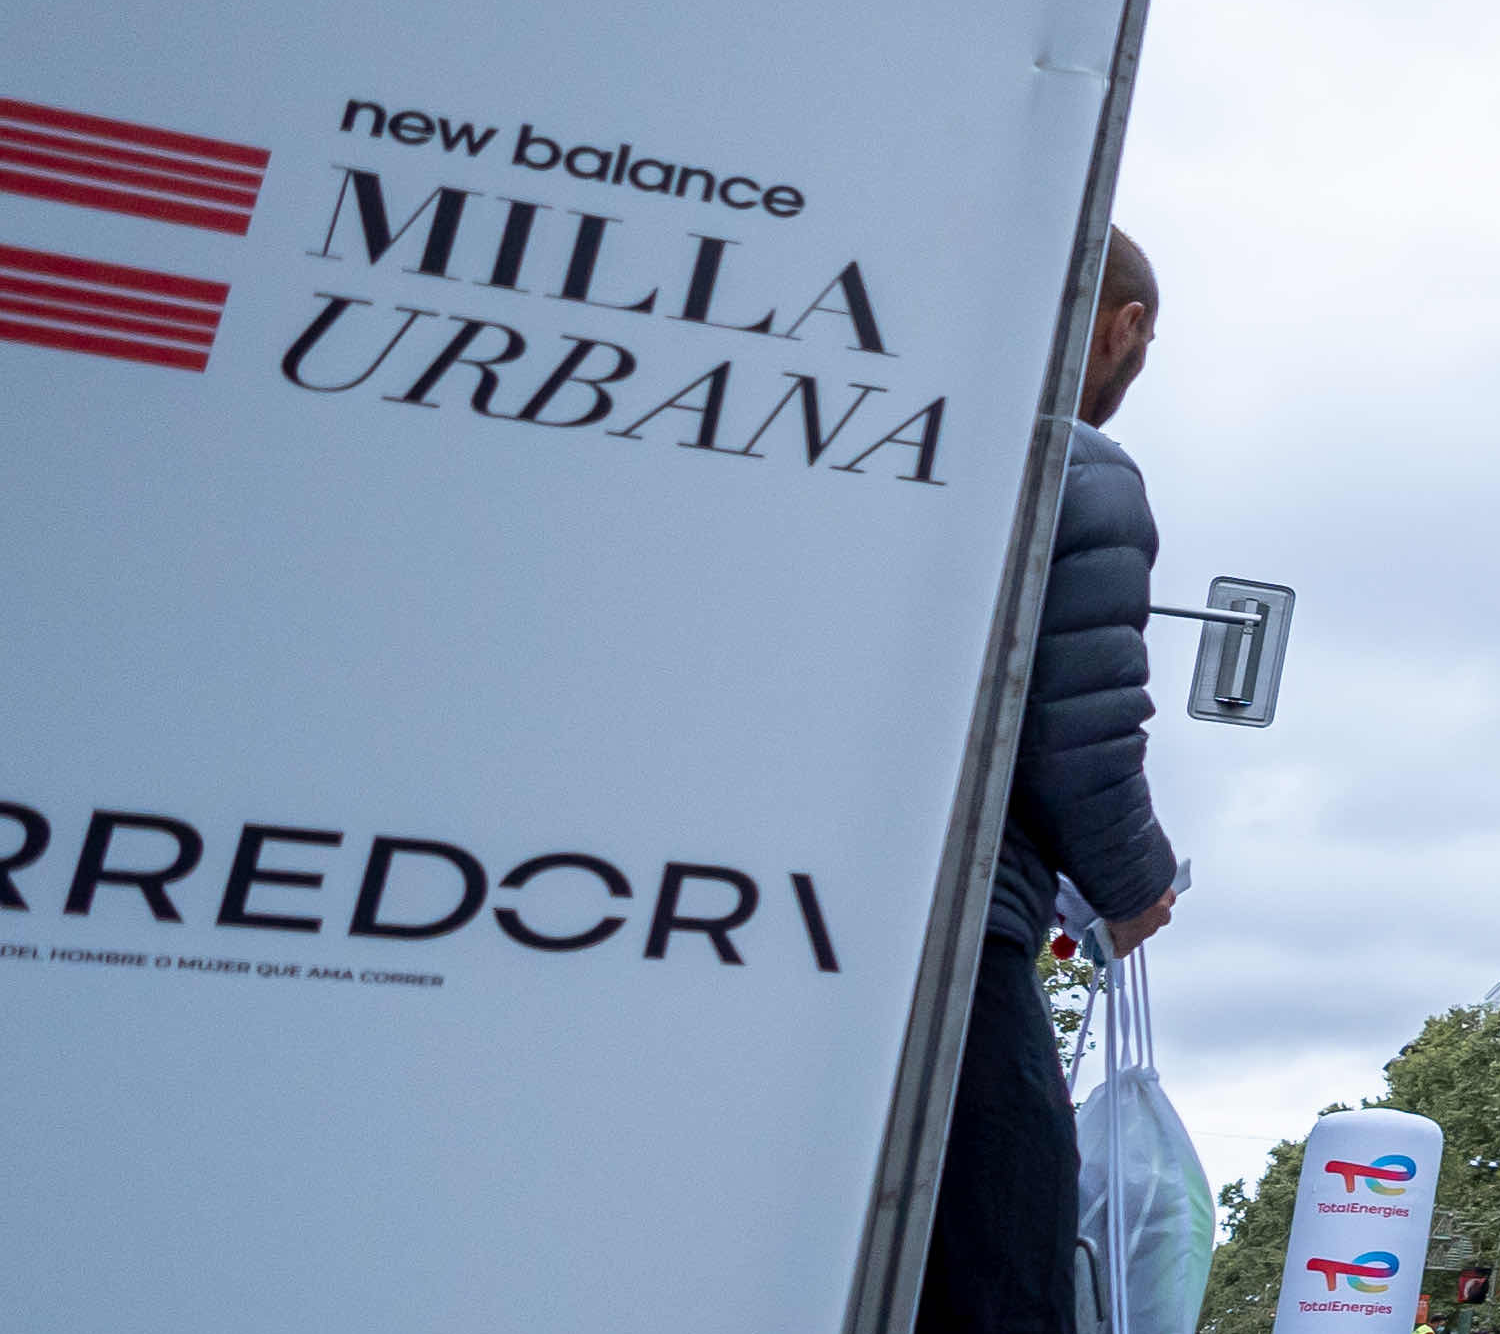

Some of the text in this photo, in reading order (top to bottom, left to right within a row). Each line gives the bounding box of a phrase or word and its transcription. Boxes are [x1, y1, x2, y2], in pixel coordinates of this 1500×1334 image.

[338, 95, 807, 219] new balance
[304, 164, 902, 358] MILLA
[278, 291, 949, 487] URBANA
[50, 947, 146, 968] HOMBRE
[155, 956, 173, 969] O
[177, 957, 251, 975] MUJER
[256, 962, 303, 979] QUE
[307, 966, 355, 983] AMA
[359, 970, 445, 988] CORRER
[1317, 1202, 1410, 1218] TotalEnergies
[1298, 1300, 1392, 1316] TotalEnergies
